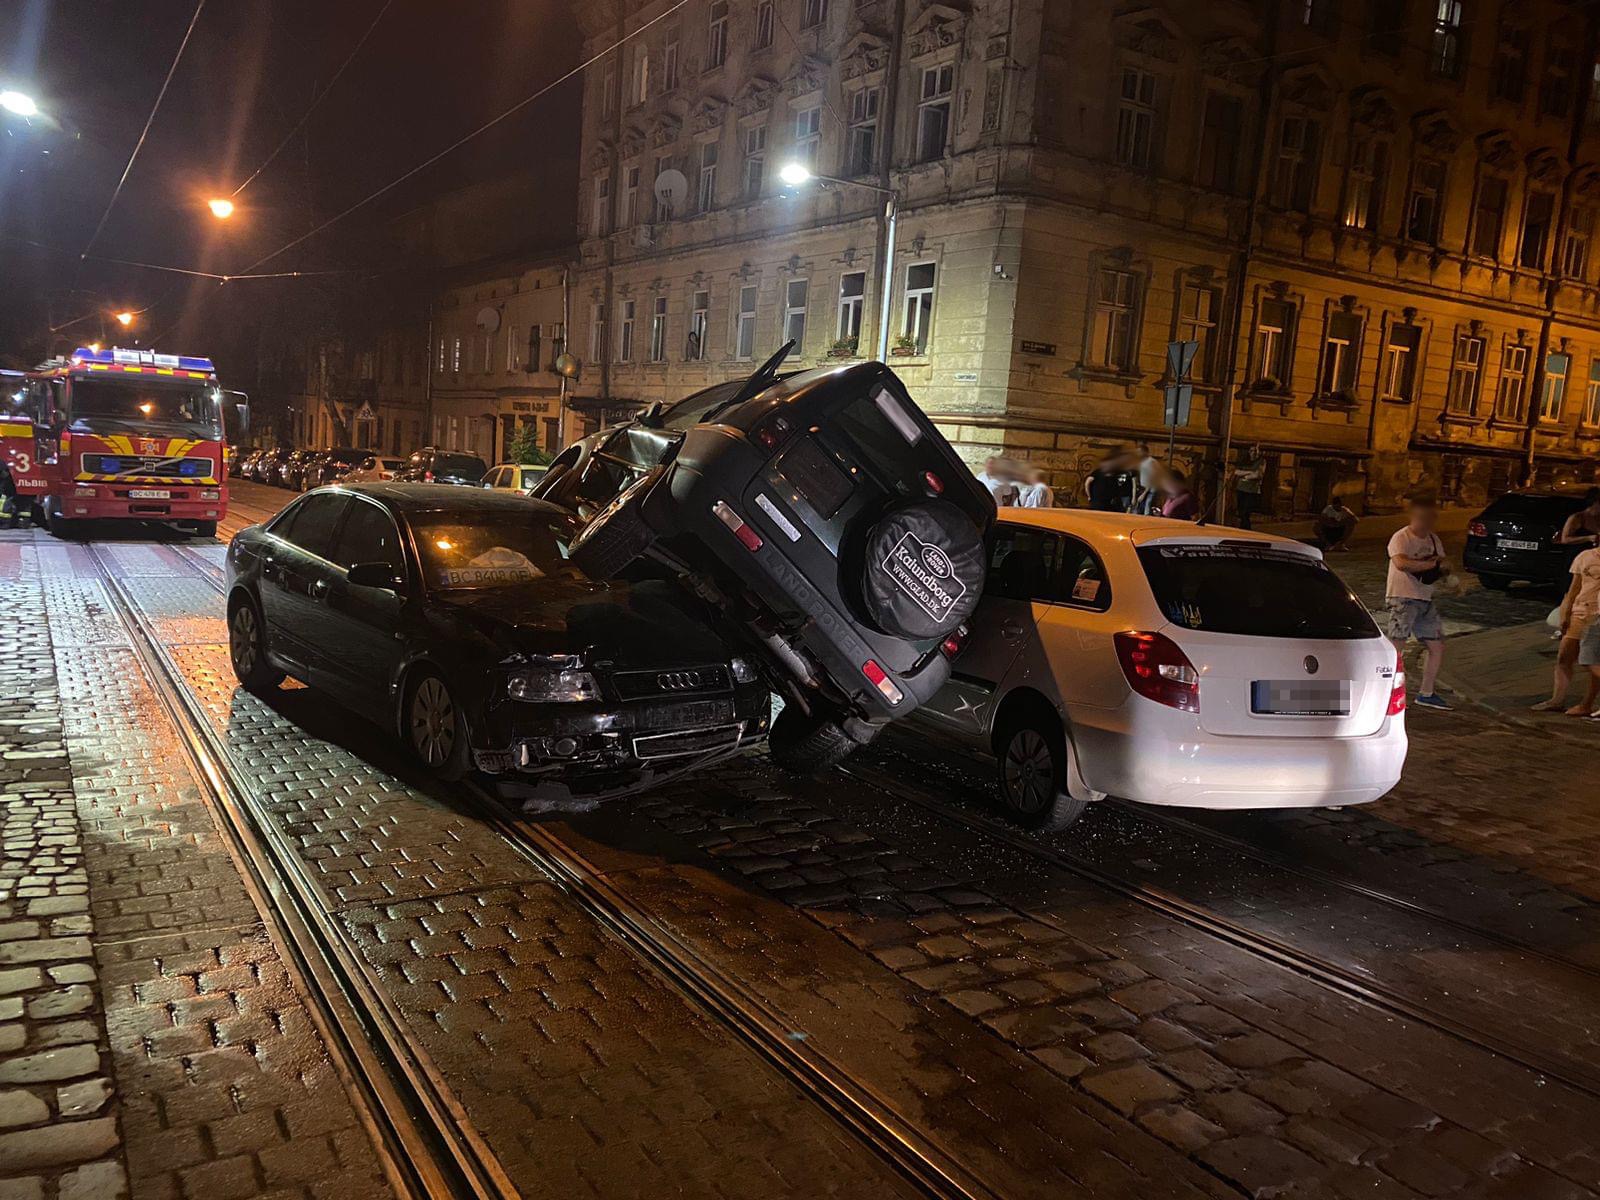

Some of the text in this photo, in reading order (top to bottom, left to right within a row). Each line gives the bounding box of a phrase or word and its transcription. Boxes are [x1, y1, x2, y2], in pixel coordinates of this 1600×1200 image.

[15, 453, 30, 473] 3
[450, 571, 470, 584] BC
[895, 546, 953, 608] Kalundborg
[765, 553, 865, 660] LAND ROVER
